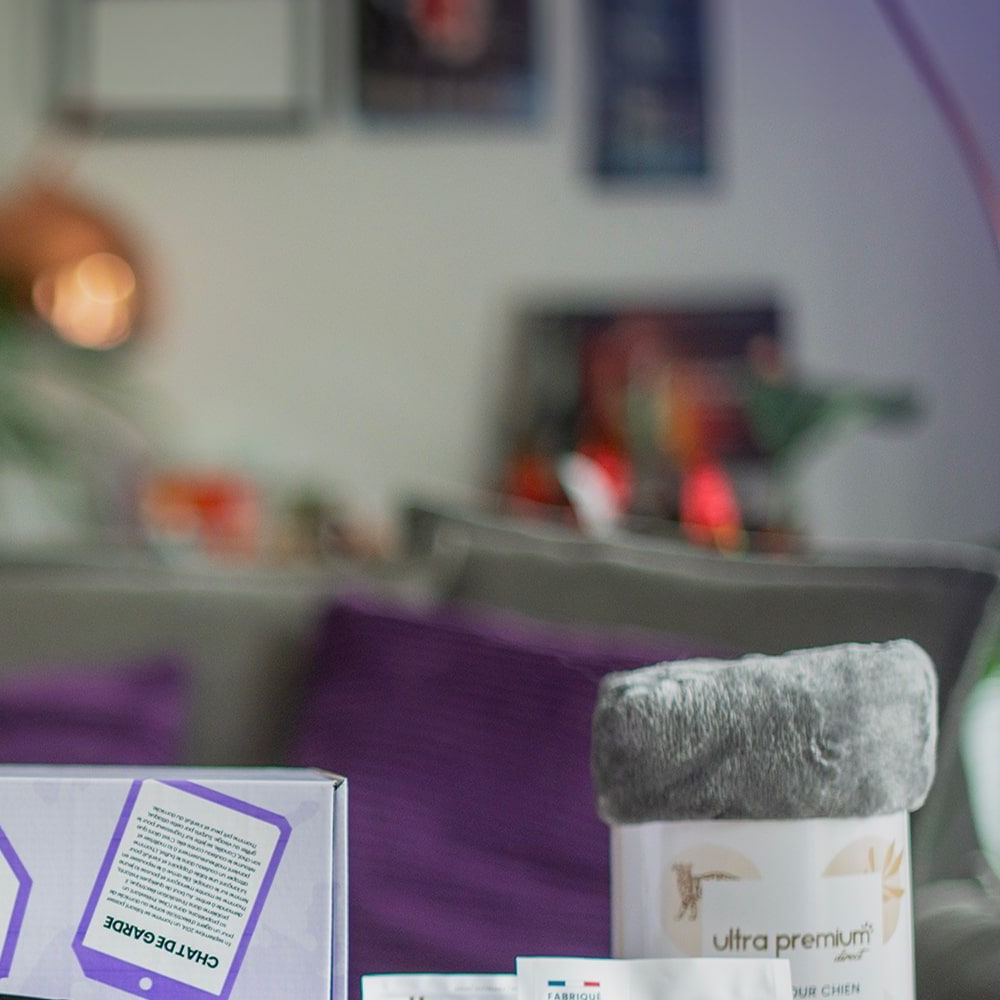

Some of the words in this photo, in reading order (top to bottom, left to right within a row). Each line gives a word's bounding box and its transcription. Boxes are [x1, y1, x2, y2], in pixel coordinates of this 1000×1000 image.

[102, 915, 156, 945] GARDE
[713, 928, 767, 950] ultra
[776, 928, 870, 958] premium
[154, 935, 176, 952] DE
[174, 943, 220, 969] CHAT
[821, 983, 859, 997] CHIEN
